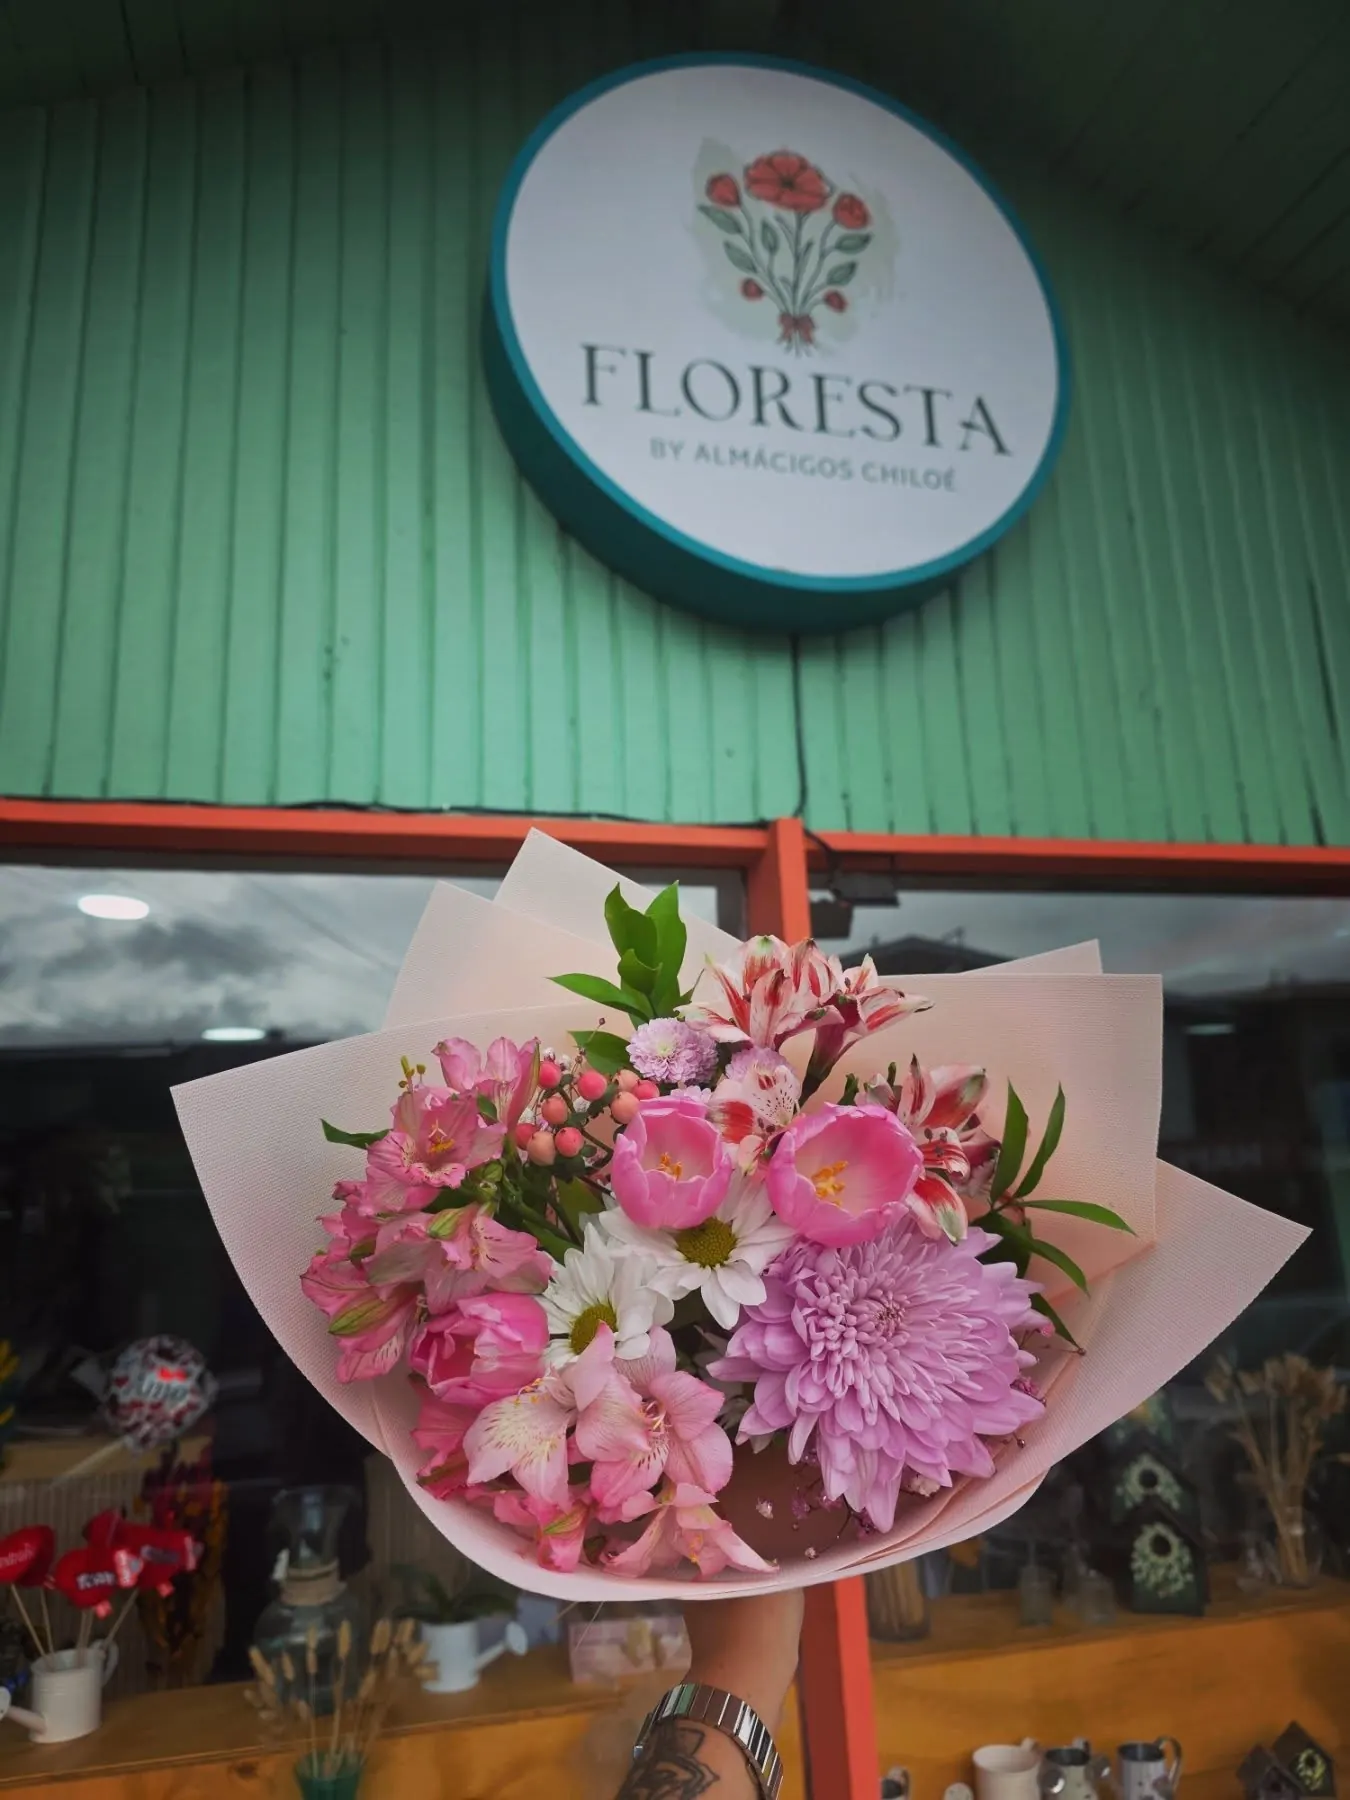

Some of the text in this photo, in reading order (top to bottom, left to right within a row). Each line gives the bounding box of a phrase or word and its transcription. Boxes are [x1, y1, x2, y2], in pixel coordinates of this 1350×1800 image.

[581, 344, 1013, 456] FLORESTA
[650, 438, 958, 492] BY ALMÁCIGOS CHILOÉ
